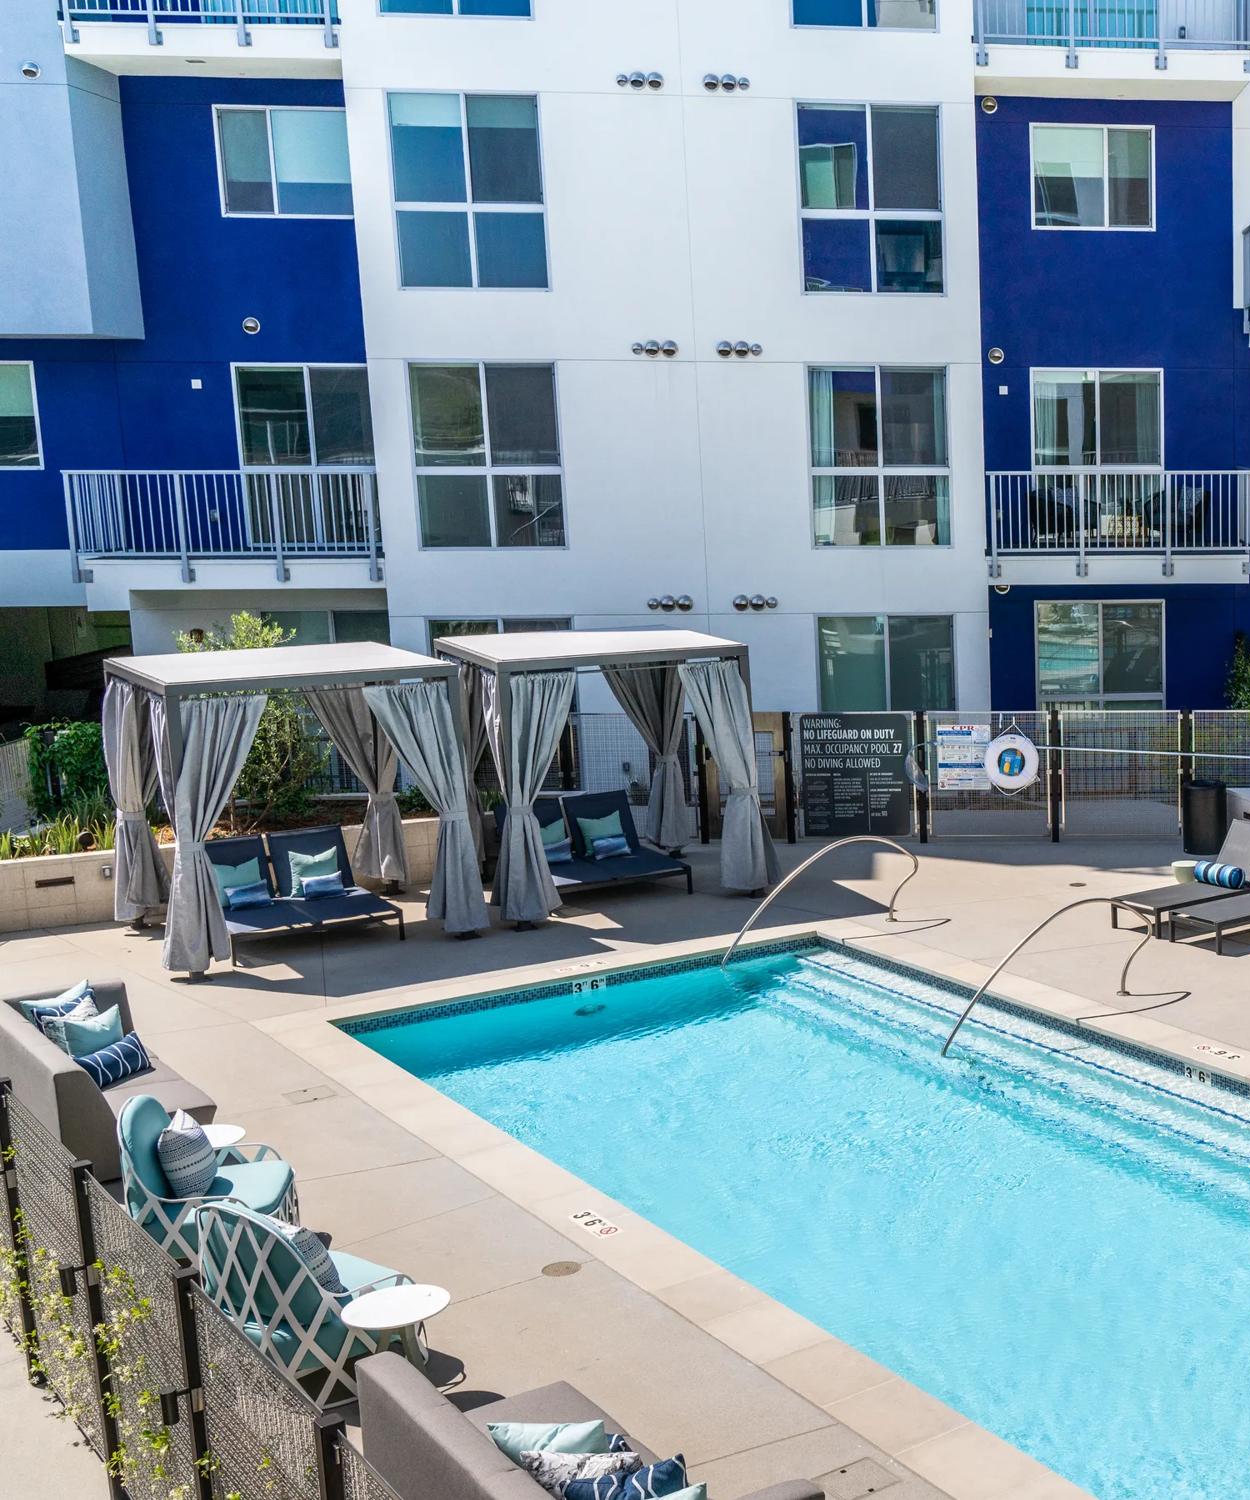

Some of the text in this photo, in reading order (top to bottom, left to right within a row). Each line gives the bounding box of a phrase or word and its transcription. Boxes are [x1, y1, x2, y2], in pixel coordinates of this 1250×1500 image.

[803, 718, 841, 729] WARNING:
[803, 728, 895, 740] NO LIFEGUARD ON DUTY
[804, 743, 902, 754] MAX. OCCUPANCY POOL 27
[805, 758, 881, 769] NO DIVING ALLOWED
[574, 982, 582, 993] 3
[591, 979, 599, 990] 6
[1185, 1066, 1193, 1079] 3
[1198, 1070, 1206, 1083] 6
[573, 1211, 591, 1219] 3
[584, 1218, 603, 1226] 6
